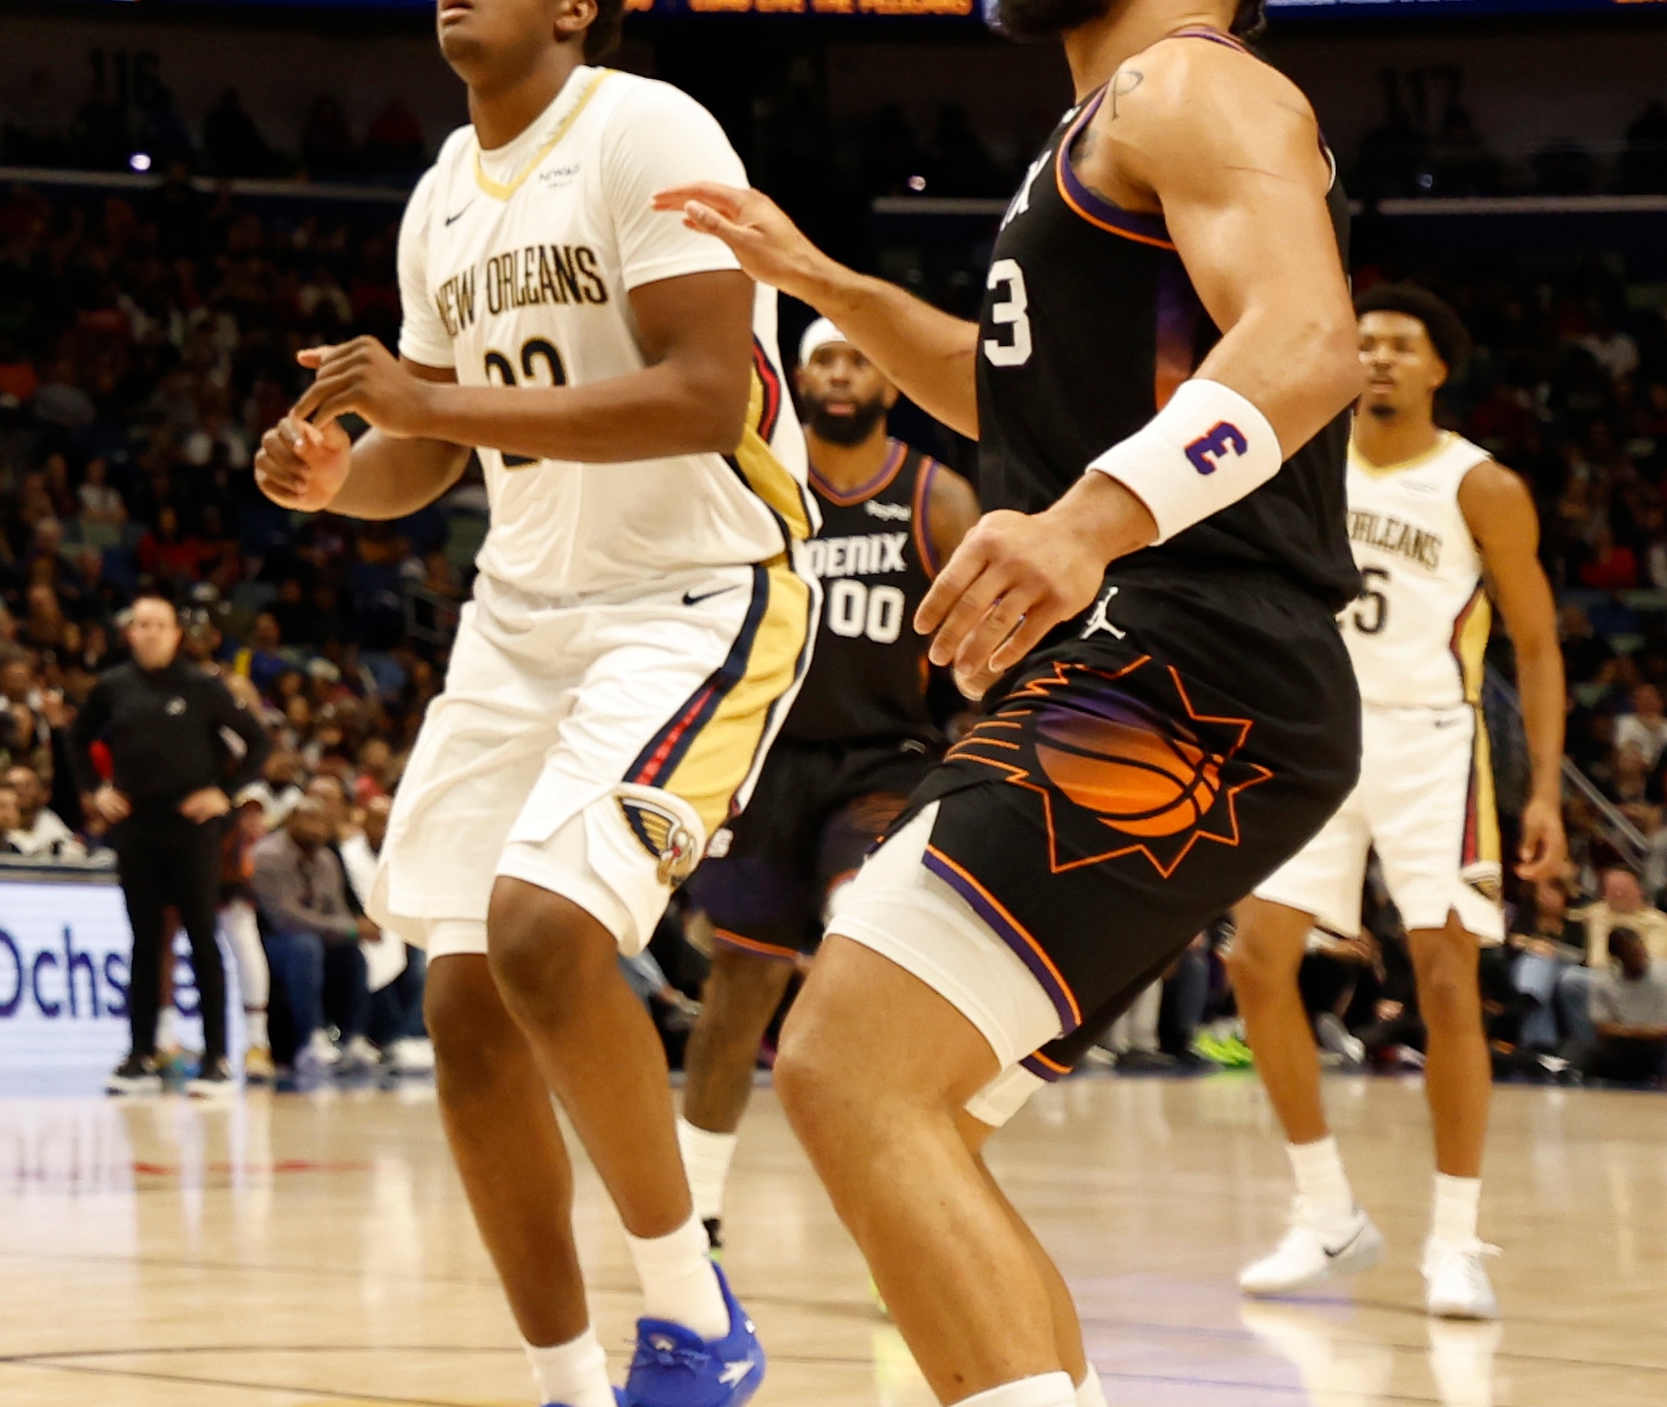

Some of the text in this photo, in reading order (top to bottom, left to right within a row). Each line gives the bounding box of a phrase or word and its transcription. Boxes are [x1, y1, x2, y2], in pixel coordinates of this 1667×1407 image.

[487, 245, 609, 316] ORLEANS
[984, 258, 1032, 367] 3
[805, 532, 908, 577] OENIX
[828, 579, 905, 644] 00
[1353, 566, 1390, 635] 5
